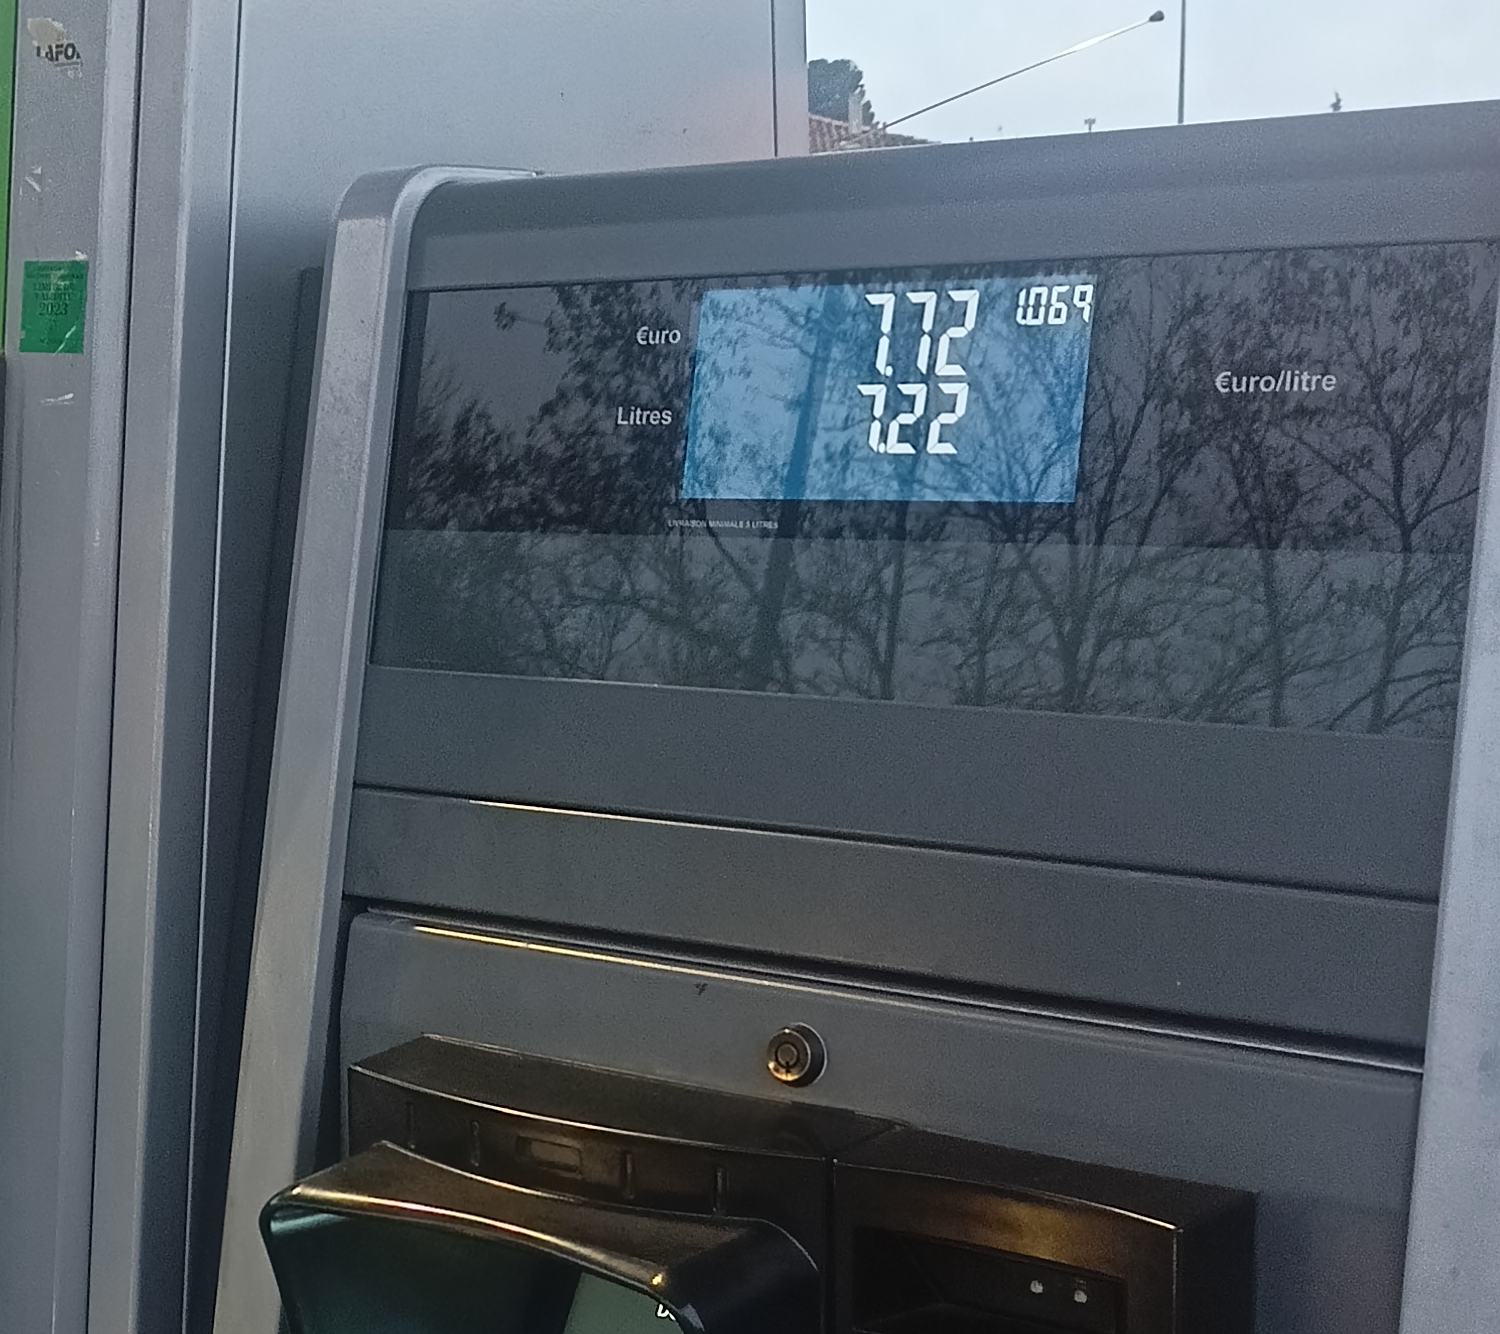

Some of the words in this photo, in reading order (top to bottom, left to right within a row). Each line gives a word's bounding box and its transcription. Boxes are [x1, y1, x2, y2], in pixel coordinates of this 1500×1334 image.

[38, 302, 69, 316] 2023
[636, 326, 681, 345] €uro
[864, 288, 980, 377] 7.72
[1214, 370, 1338, 394] €uro/litre
[617, 406, 673, 425] Litres
[856, 381, 970, 455] 7.22
